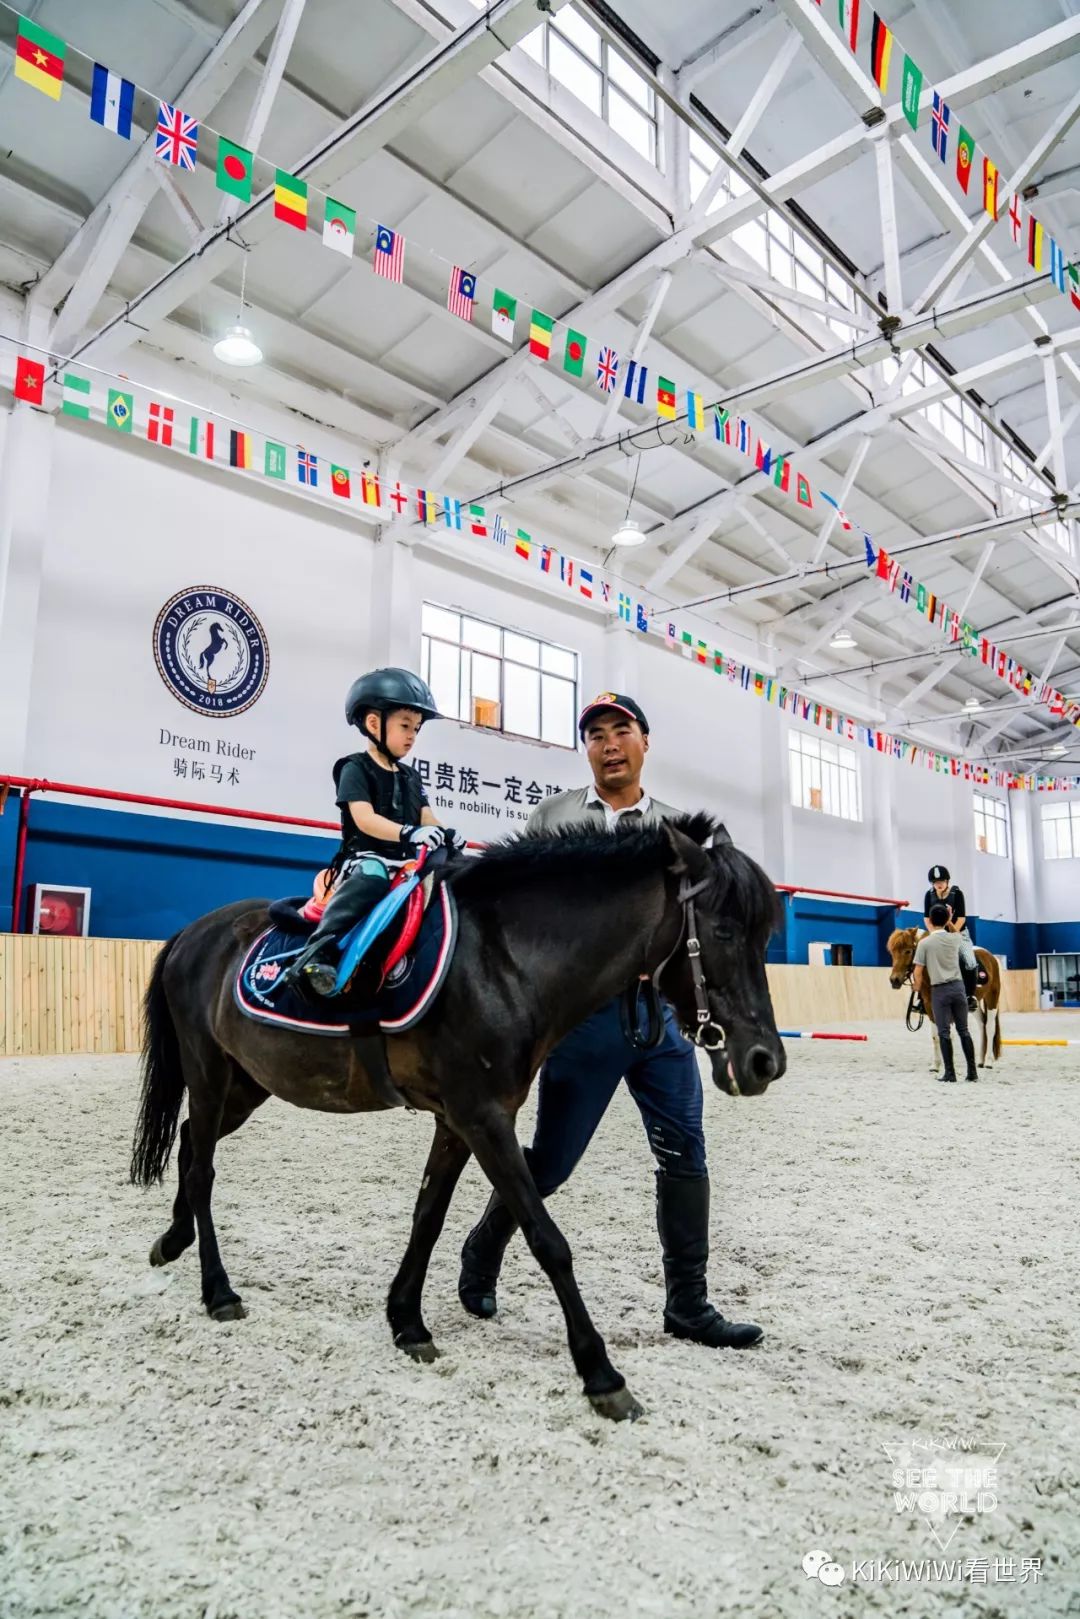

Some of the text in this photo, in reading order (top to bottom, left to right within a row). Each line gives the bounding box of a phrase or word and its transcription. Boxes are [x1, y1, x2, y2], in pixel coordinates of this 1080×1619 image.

[168, 595, 260, 648] DREAM RIDER
[198, 694, 223, 707] 2018
[159, 729, 257, 761] Dream Rider
[173, 757, 240, 787] 骑际马术
[435, 795, 529, 821] the nobility is su
